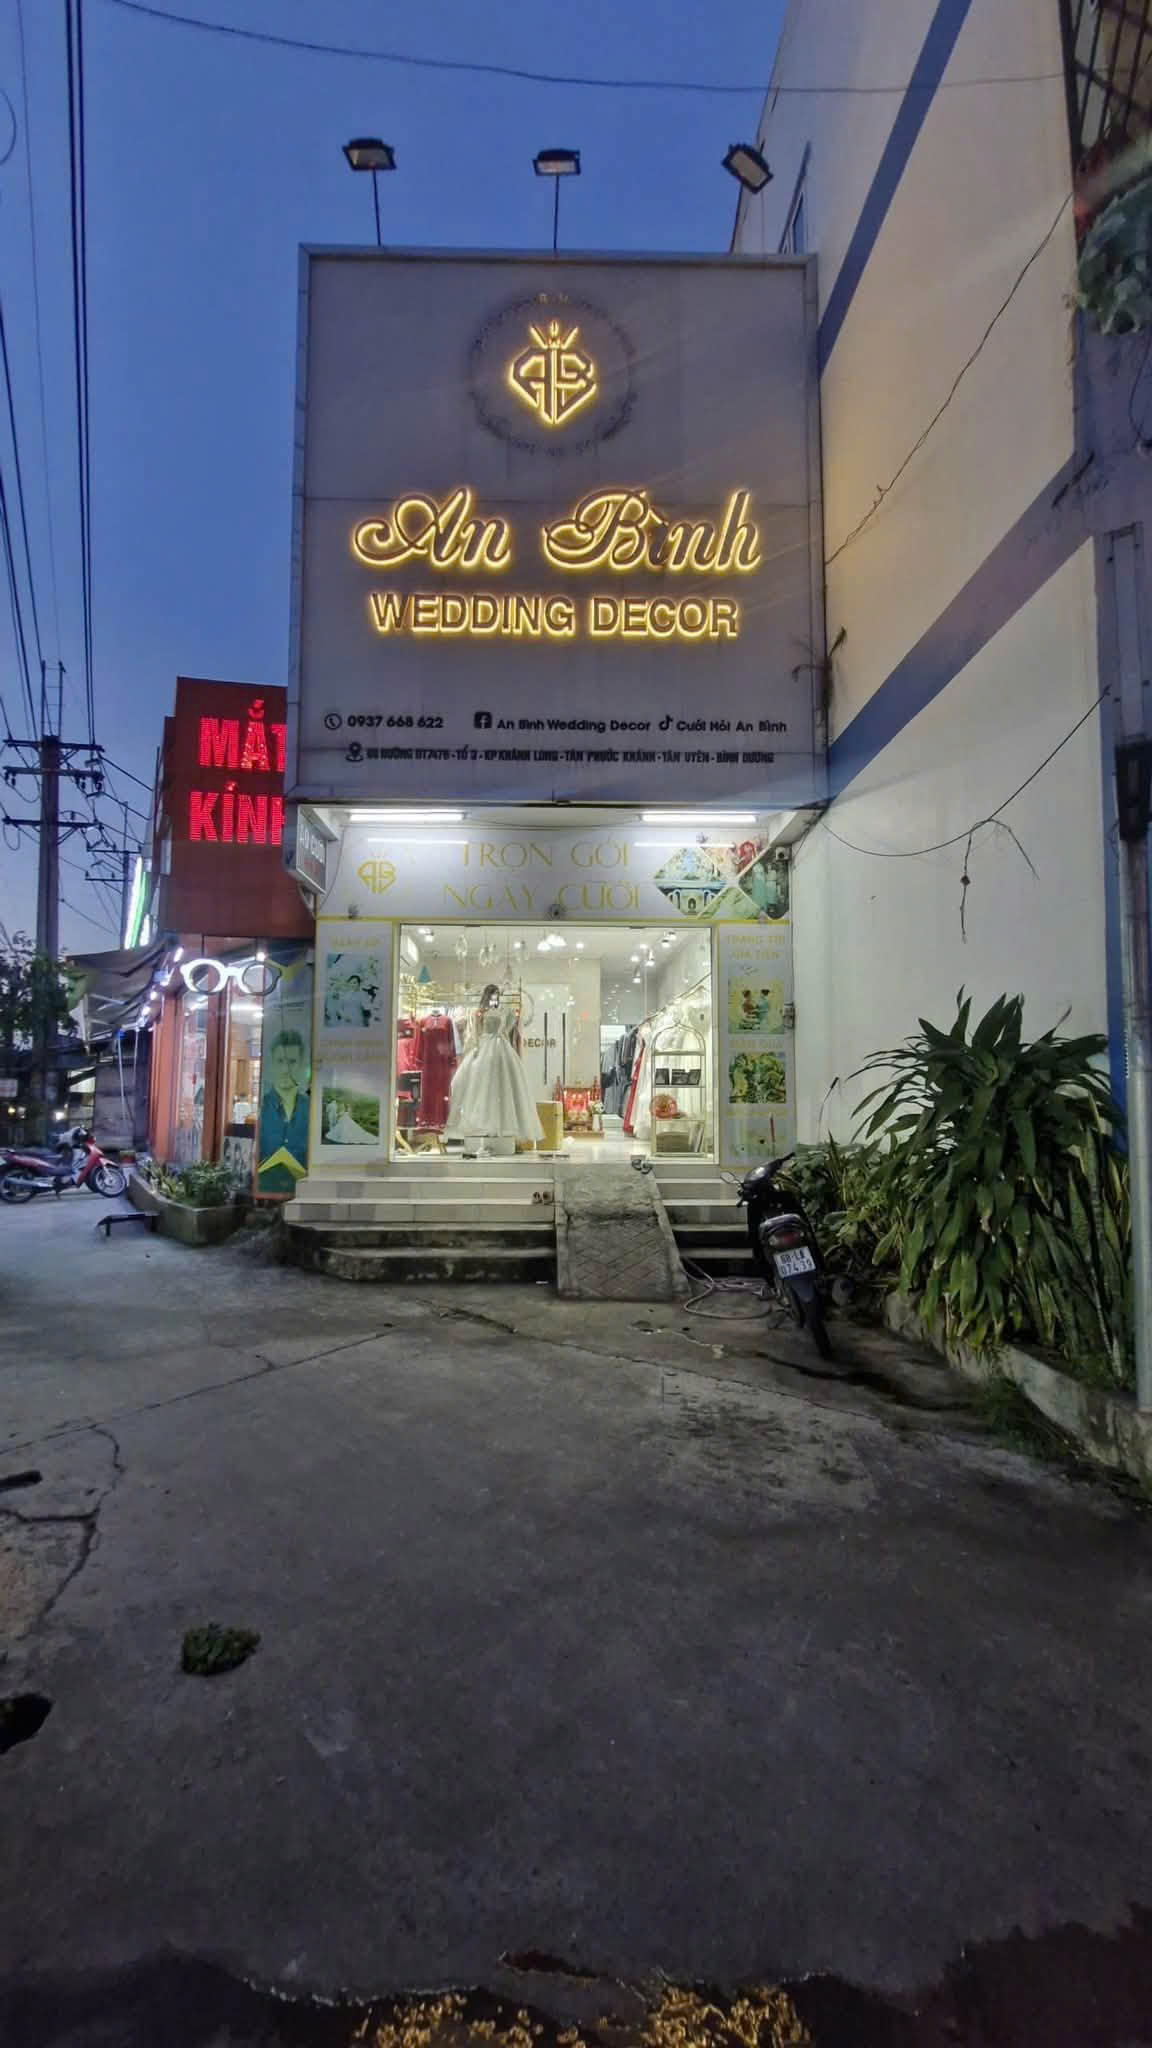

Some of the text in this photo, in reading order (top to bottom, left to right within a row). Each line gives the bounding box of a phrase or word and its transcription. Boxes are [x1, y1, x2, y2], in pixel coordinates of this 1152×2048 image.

[354, 487, 761, 571] An Bình
[370, 592, 739, 638] WEDDING DECOR
[347, 714, 383, 728] 0937
[497, 718, 514, 731] An
[547, 719, 606, 733] Wedding
[610, 719, 651, 732] Decor
[736, 720, 754, 732] An
[758, 719, 787, 732] Bình
